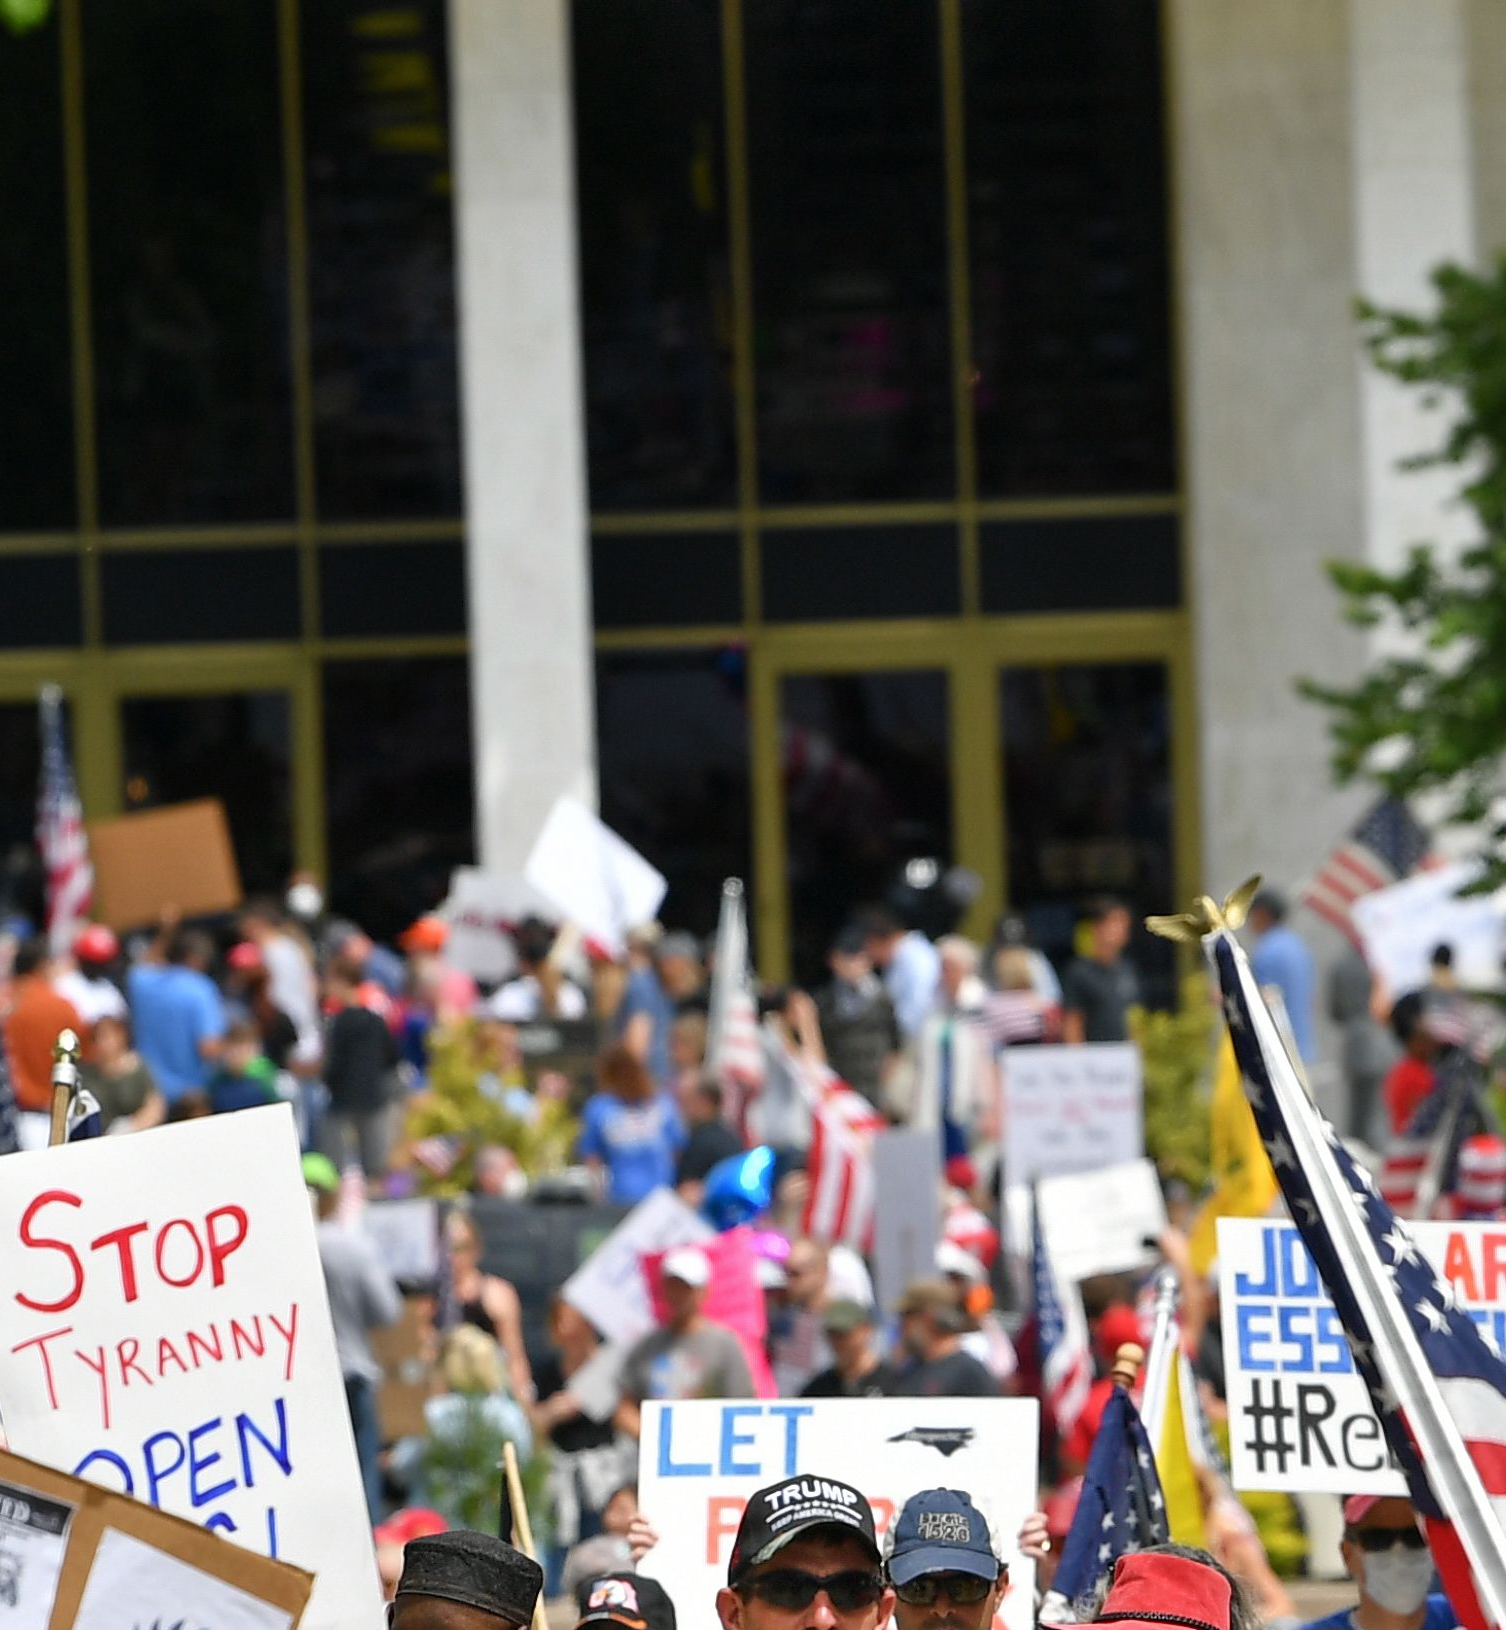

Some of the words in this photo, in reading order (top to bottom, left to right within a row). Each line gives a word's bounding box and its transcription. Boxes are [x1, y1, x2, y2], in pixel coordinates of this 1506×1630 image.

[13, 1190, 249, 1314] STOP
[10, 1303, 299, 1430] TYRANNY
[656, 1405, 814, 1478] LET
[1243, 1378, 1386, 1474] #Re
[763, 1479, 858, 1511] TRUMP
